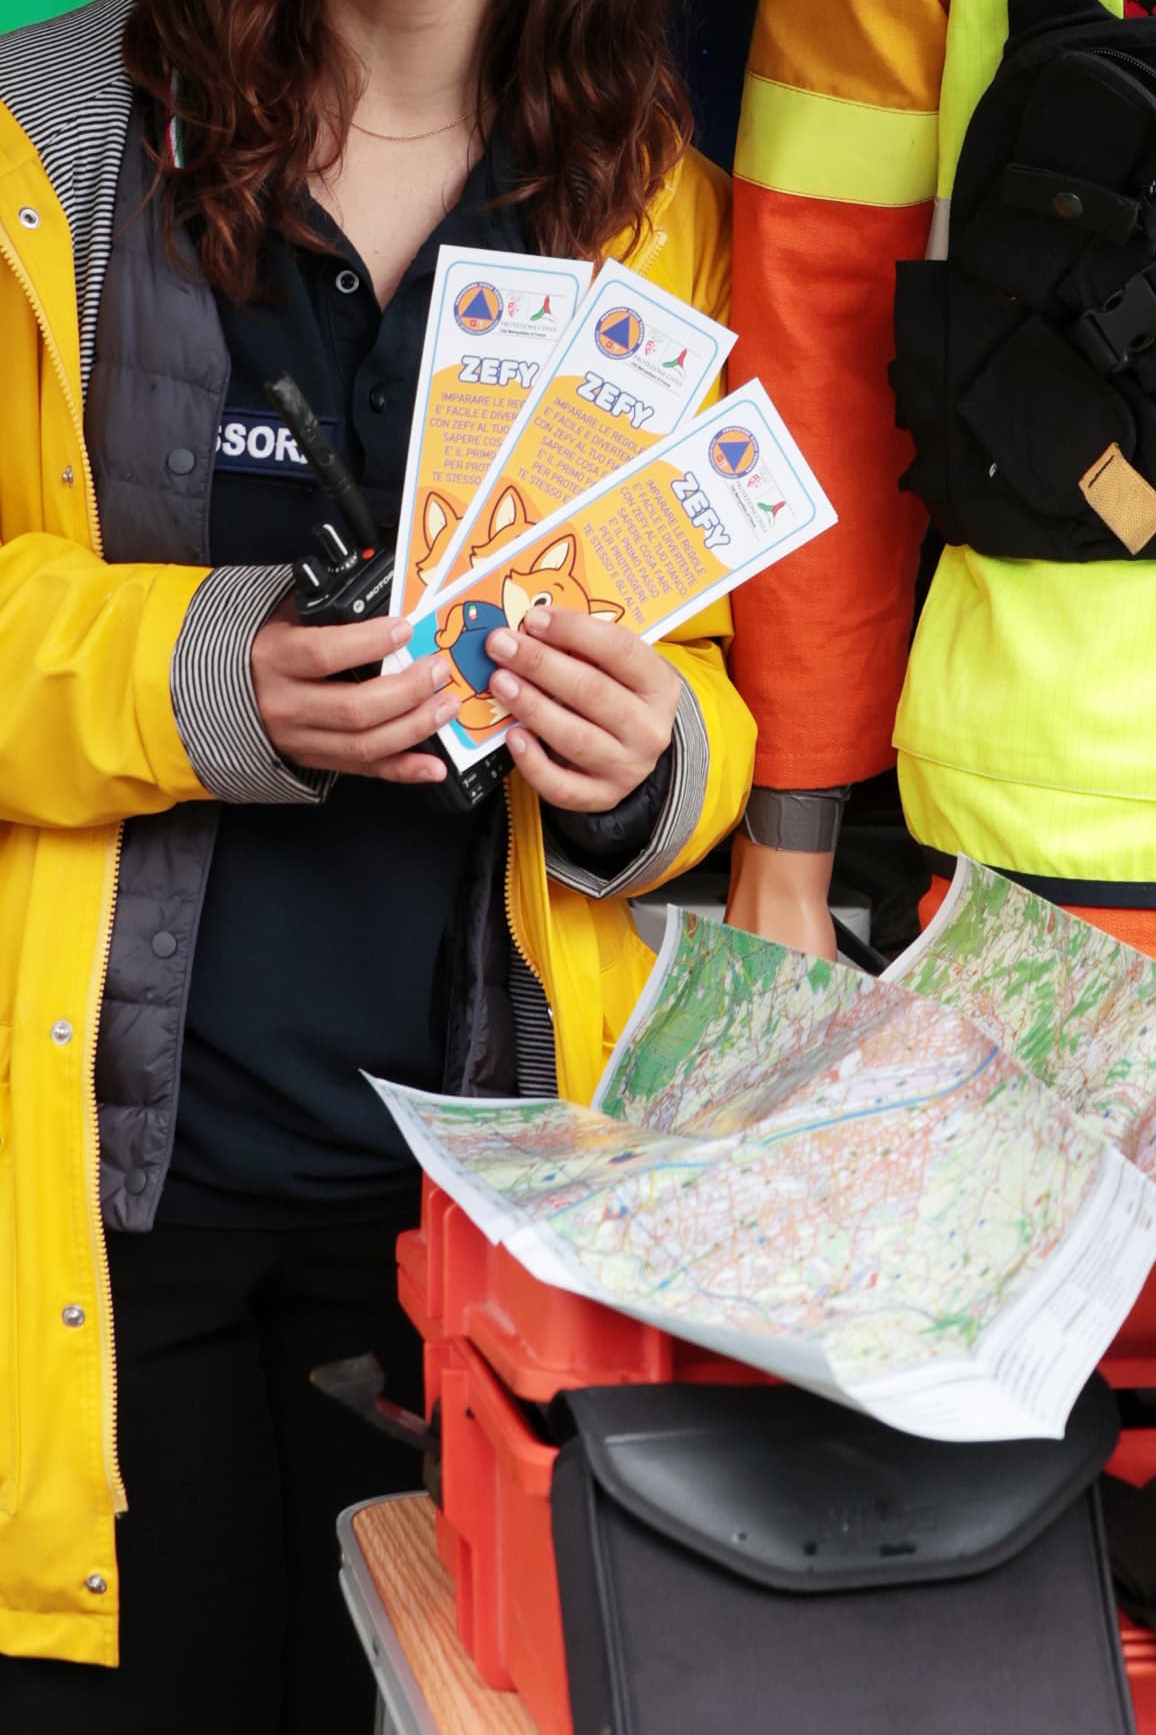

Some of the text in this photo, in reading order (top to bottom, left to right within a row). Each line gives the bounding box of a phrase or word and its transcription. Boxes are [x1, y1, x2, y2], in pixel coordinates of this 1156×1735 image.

[458, 355, 539, 388] ZEFY
[442, 393, 489, 405] IMPARARE
[446, 406, 477, 416] FACILE
[491, 411, 517, 420] DIVER
[554, 398, 596, 427] IMPARARE
[598, 424, 610, 435] LE
[576, 371, 654, 428] ZEFY
[216, 423, 308, 464] SOR
[430, 418, 448, 427] CON
[452, 420, 474, 430] ZEFY
[477, 423, 487, 431] AL
[443, 433, 501, 446] SAPERE COS
[534, 416, 553, 432] CON
[553, 428, 574, 443] ZEFY
[589, 448, 606, 463] TUO
[553, 412, 583, 434] FACILE
[591, 435, 633, 461] DIVERTEN
[444, 459, 489, 471] PER PROT
[532, 461, 550, 476] PER
[541, 436, 599, 475] SAPERE COSA
[556, 460, 584, 481] PRIMO
[530, 475, 562, 498] STESSO
[620, 486, 635, 506] CON
[632, 508, 648, 528] ZEFY
[654, 542, 668, 561] TUO
[647, 479, 705, 574] IMPARARE LE REGOLE
[671, 471, 730, 549] ZEFY
[590, 536, 614, 571] STESSO
[618, 508, 672, 593] SAPERE COSA FARE
[638, 492, 661, 524] FACILE
[662, 532, 696, 585] DIVERTENTE
[599, 525, 648, 601] PER PROTEGGERE
[621, 537, 641, 566] PRIMO
[638, 567, 659, 598] PASSO
